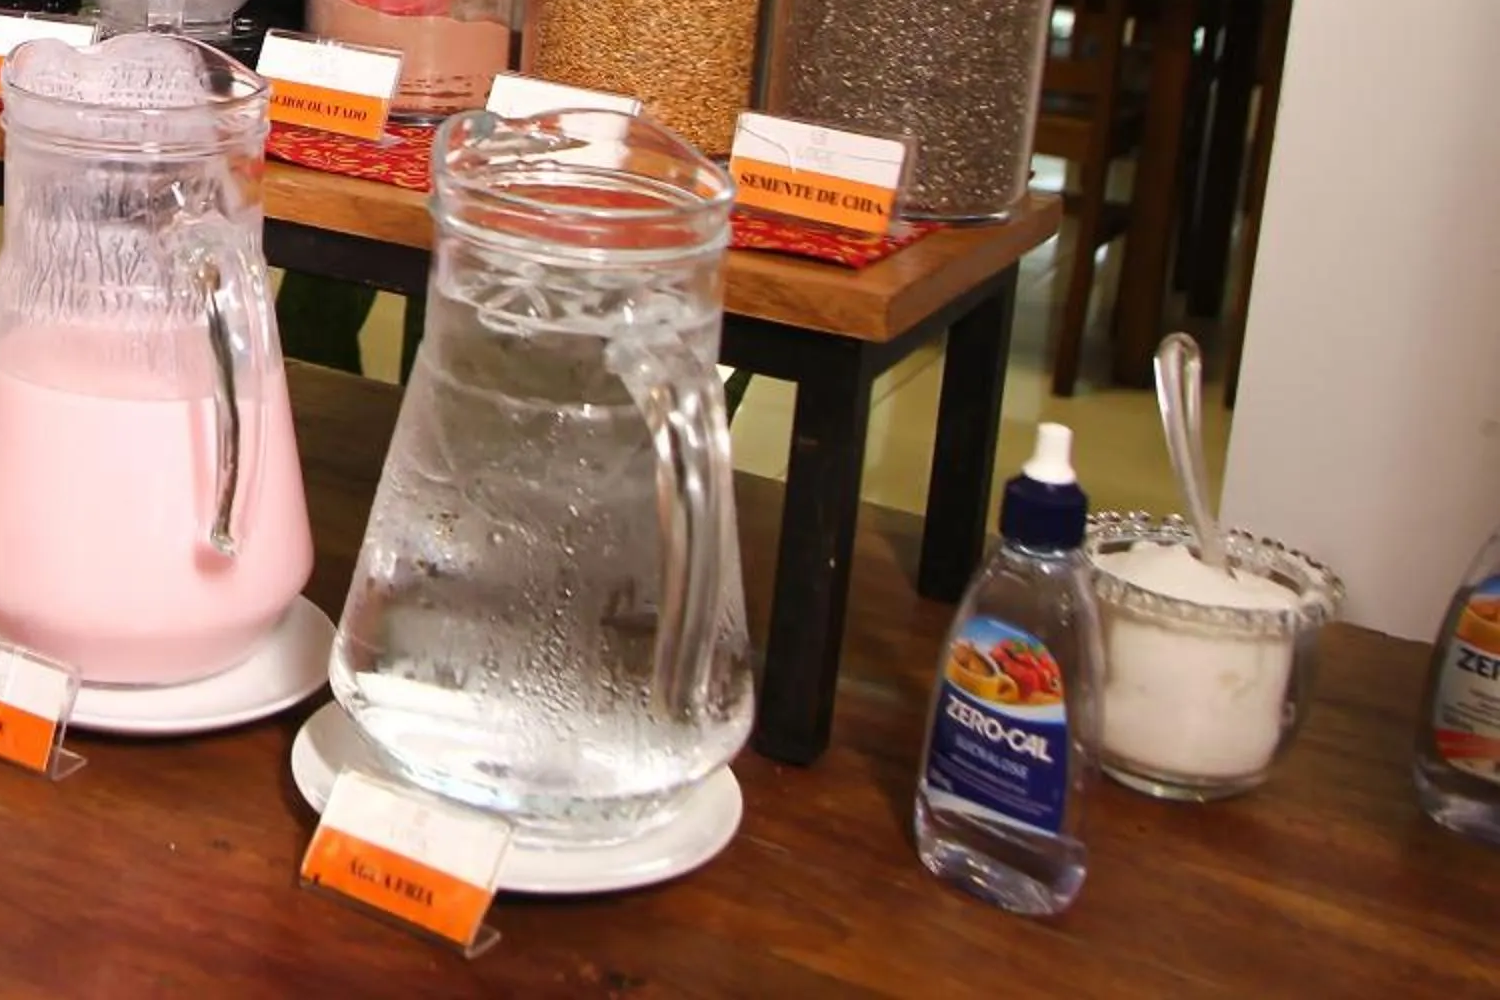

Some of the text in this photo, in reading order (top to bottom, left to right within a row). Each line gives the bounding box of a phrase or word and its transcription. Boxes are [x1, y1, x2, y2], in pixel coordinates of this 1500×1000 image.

[739, 171, 886, 215] SEMENTE DE CHIA
[945, 693, 1054, 765] ZERO-CAL
